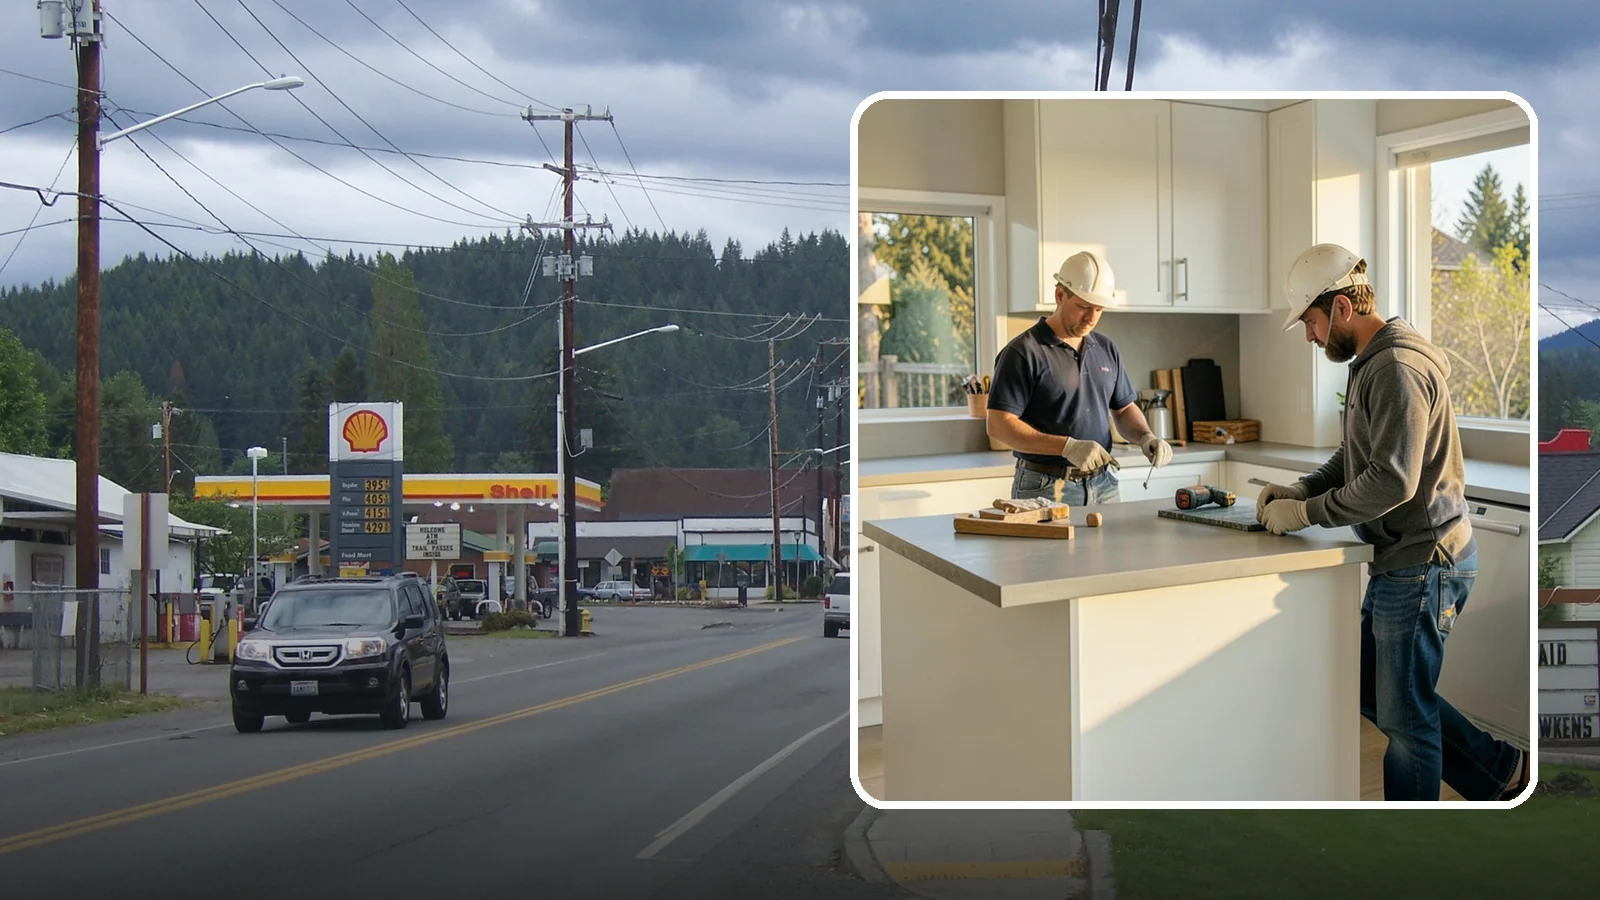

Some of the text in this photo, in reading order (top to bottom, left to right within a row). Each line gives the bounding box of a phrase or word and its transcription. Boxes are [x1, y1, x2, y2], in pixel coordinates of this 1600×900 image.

[366, 479, 384, 490] 395
[490, 484, 547, 499] Shell
[366, 494, 384, 504] 405
[366, 508, 384, 518] 415
[366, 522, 384, 533] 429
